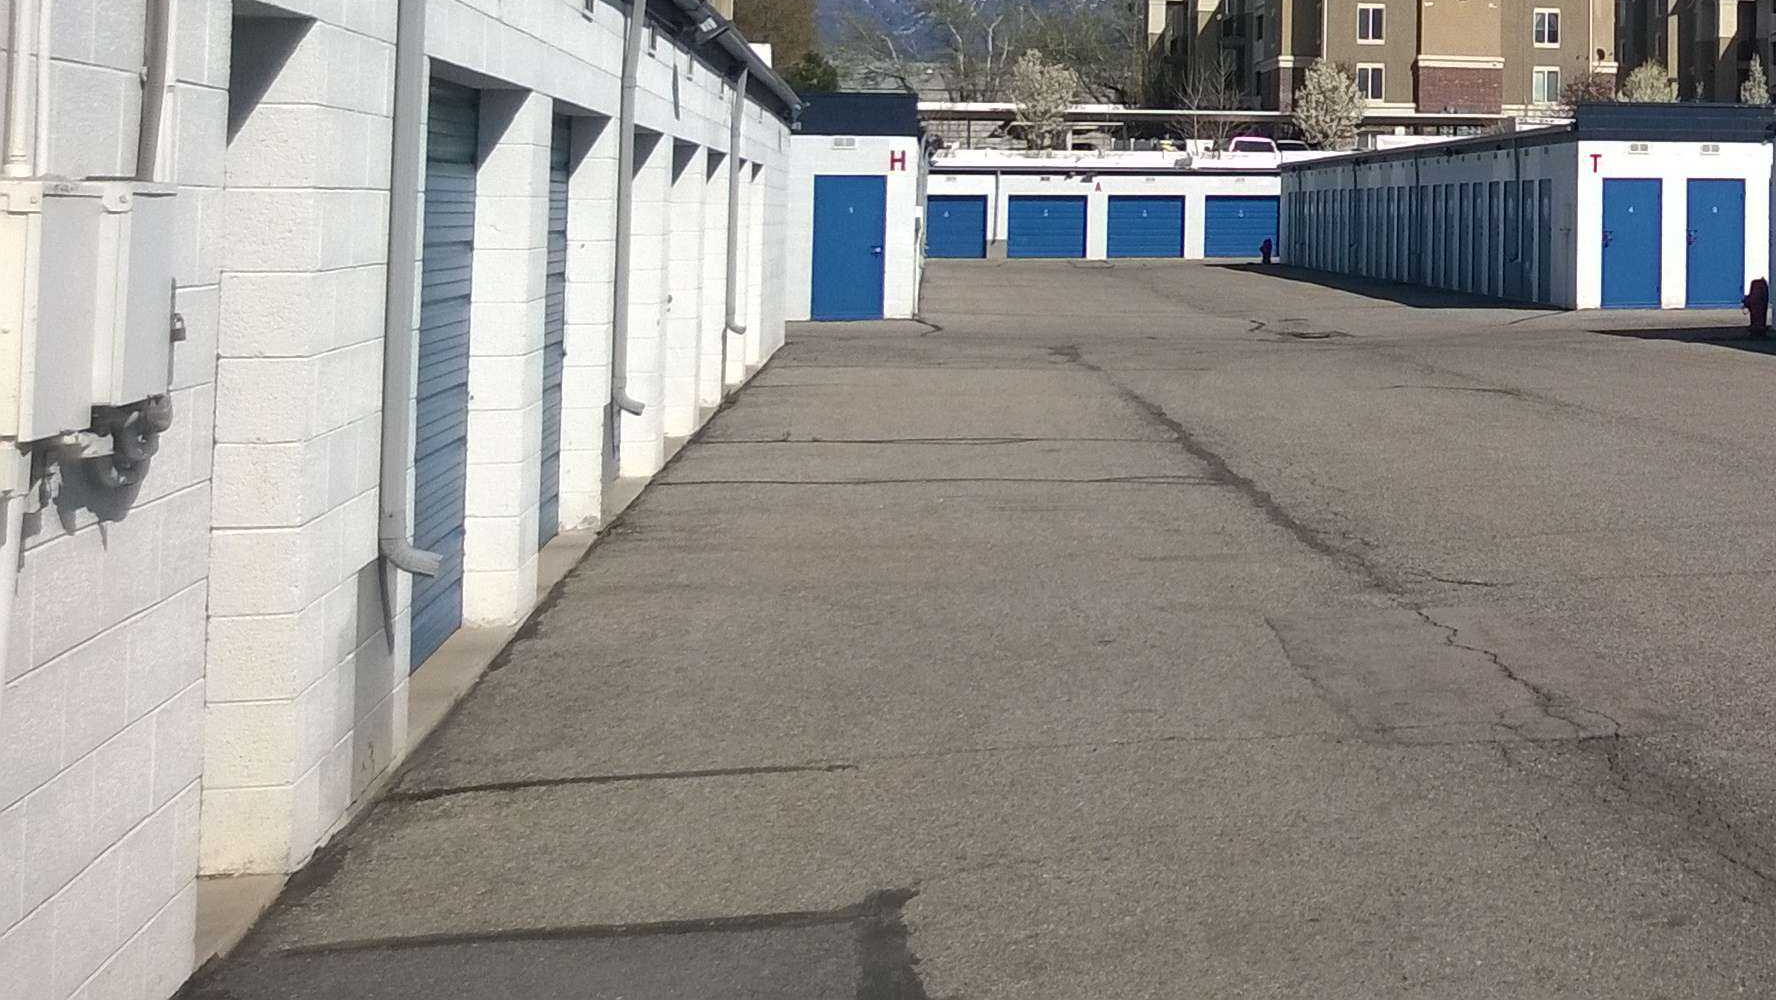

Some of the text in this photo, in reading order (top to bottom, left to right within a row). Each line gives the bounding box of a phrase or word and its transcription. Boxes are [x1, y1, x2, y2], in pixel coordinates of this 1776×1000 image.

[890, 150, 906, 171] H
[1590, 154, 1602, 173] T
[1095, 182, 1102, 192] A
